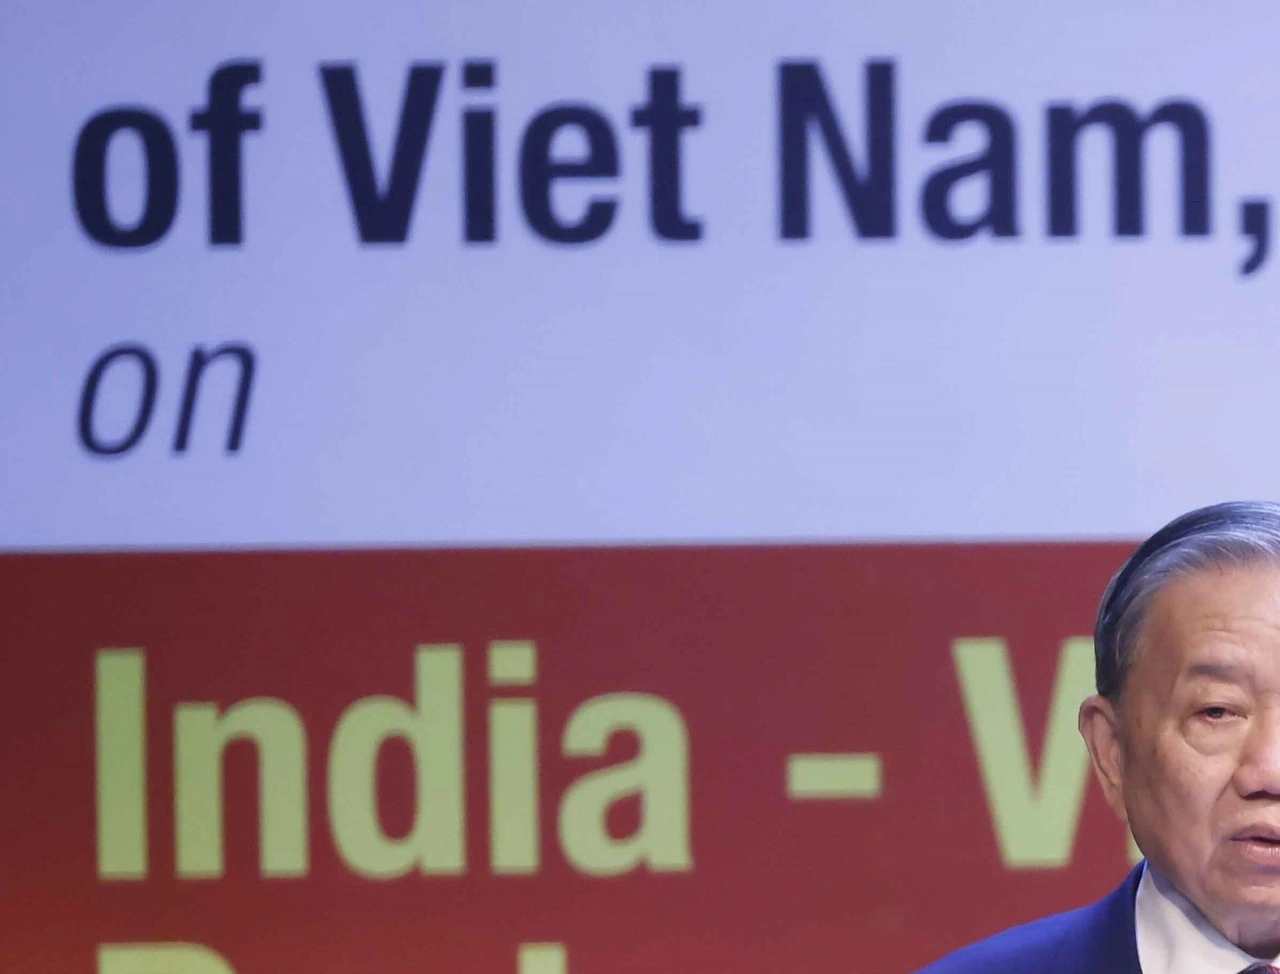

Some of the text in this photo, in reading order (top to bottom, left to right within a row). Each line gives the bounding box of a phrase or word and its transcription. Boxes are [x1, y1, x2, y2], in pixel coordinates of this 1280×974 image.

[70, 60, 264, 247] of
[316, 62, 702, 247] Viet
[776, 58, 1275, 276] Nam,
[76, 341, 258, 457] on
[95, 640, 693, 881] India
